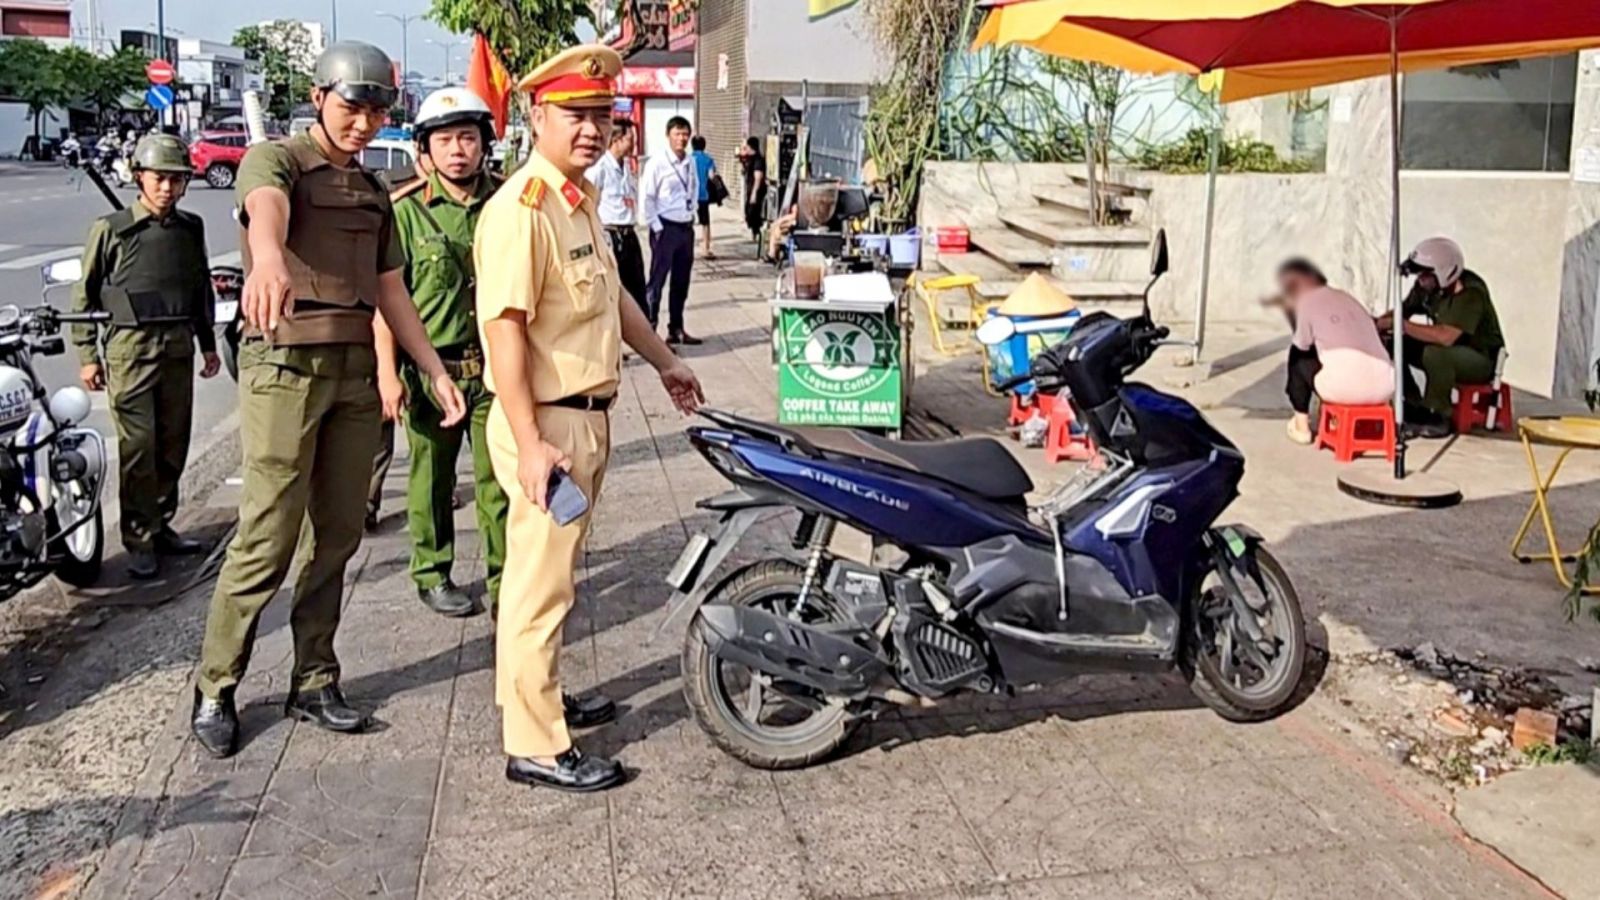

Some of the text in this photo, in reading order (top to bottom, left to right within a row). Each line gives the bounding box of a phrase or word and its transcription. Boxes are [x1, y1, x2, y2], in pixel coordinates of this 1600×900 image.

[802, 313, 826, 335] CAO
[803, 370, 877, 392] Legend Coffee
[782, 398, 896, 415] COFFEE TAKE AWAY
[800, 467, 911, 511] AIRBLADE
